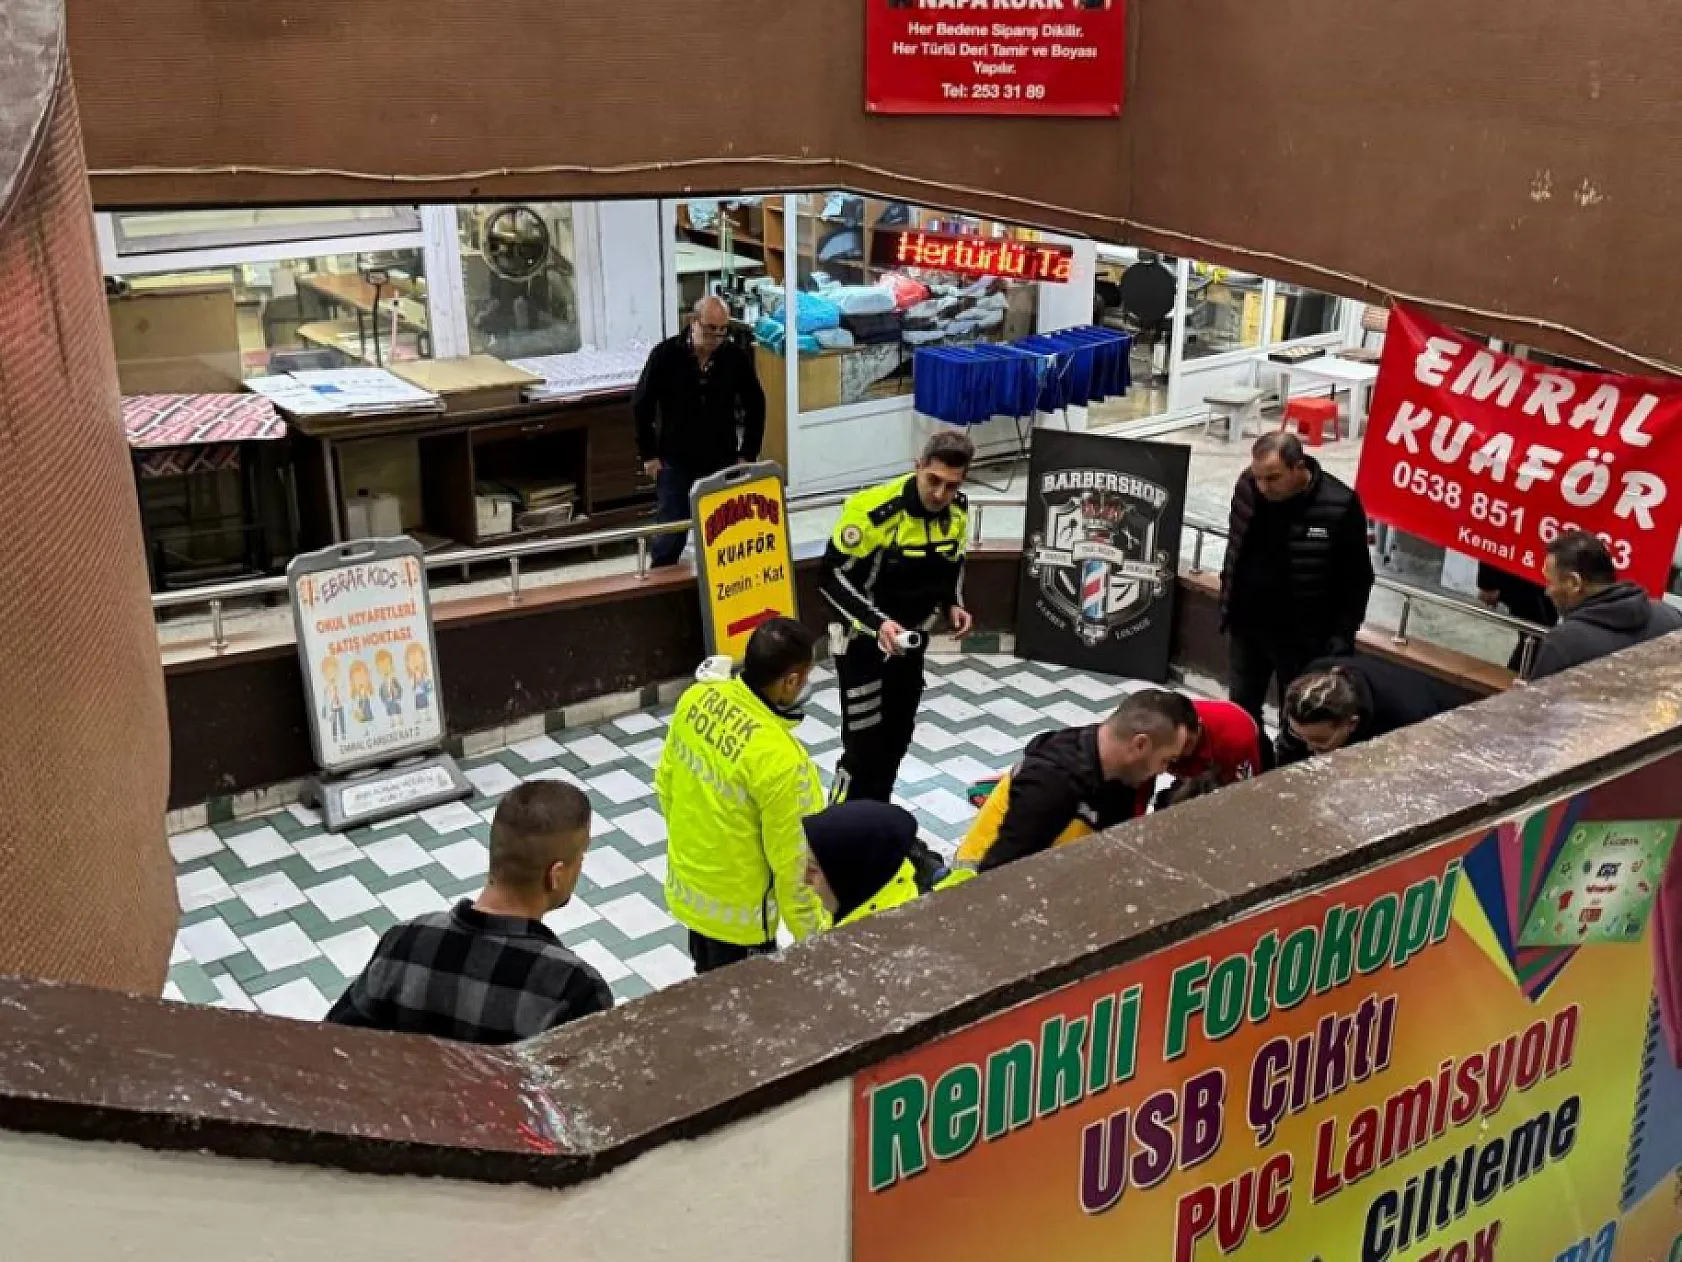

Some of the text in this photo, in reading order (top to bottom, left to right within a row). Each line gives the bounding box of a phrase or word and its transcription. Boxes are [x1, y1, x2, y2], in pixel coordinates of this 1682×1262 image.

[892, 41, 1097, 60] Her Türlü Deri Tamir ve Boyası
[907, 22, 934, 36] Her
[936, 22, 988, 37] Bedene
[941, 83, 1046, 99] Tel: 253 31 89
[897, 231, 1071, 279] Hertürlü Ta
[1414, 336, 1660, 447] EMRAL
[1043, 471, 1168, 508] BARBERSHOP
[1385, 401, 1667, 530] KUAFÖR
[1392, 461, 1462, 509] 0538
[1470, 492, 1525, 534] 851
[1539, 516, 1581, 543] 6
[717, 532, 776, 567] KUAFÖR
[1458, 526, 1535, 567] Kemal &
[321, 566, 364, 604] EBRAR
[716, 577, 752, 601] Zemin
[763, 565, 785, 584] Kat
[687, 704, 745, 762] POLİSİ
[700, 688, 762, 741] TRAFİK
[868, 857, 1463, 1193] Renkli Fotokopi
[1080, 992, 1398, 1214] USB Çıktı
[1174, 1002, 1581, 1262] PVC Lamisyon
[1361, 1095, 1581, 1262] Ciltleme
